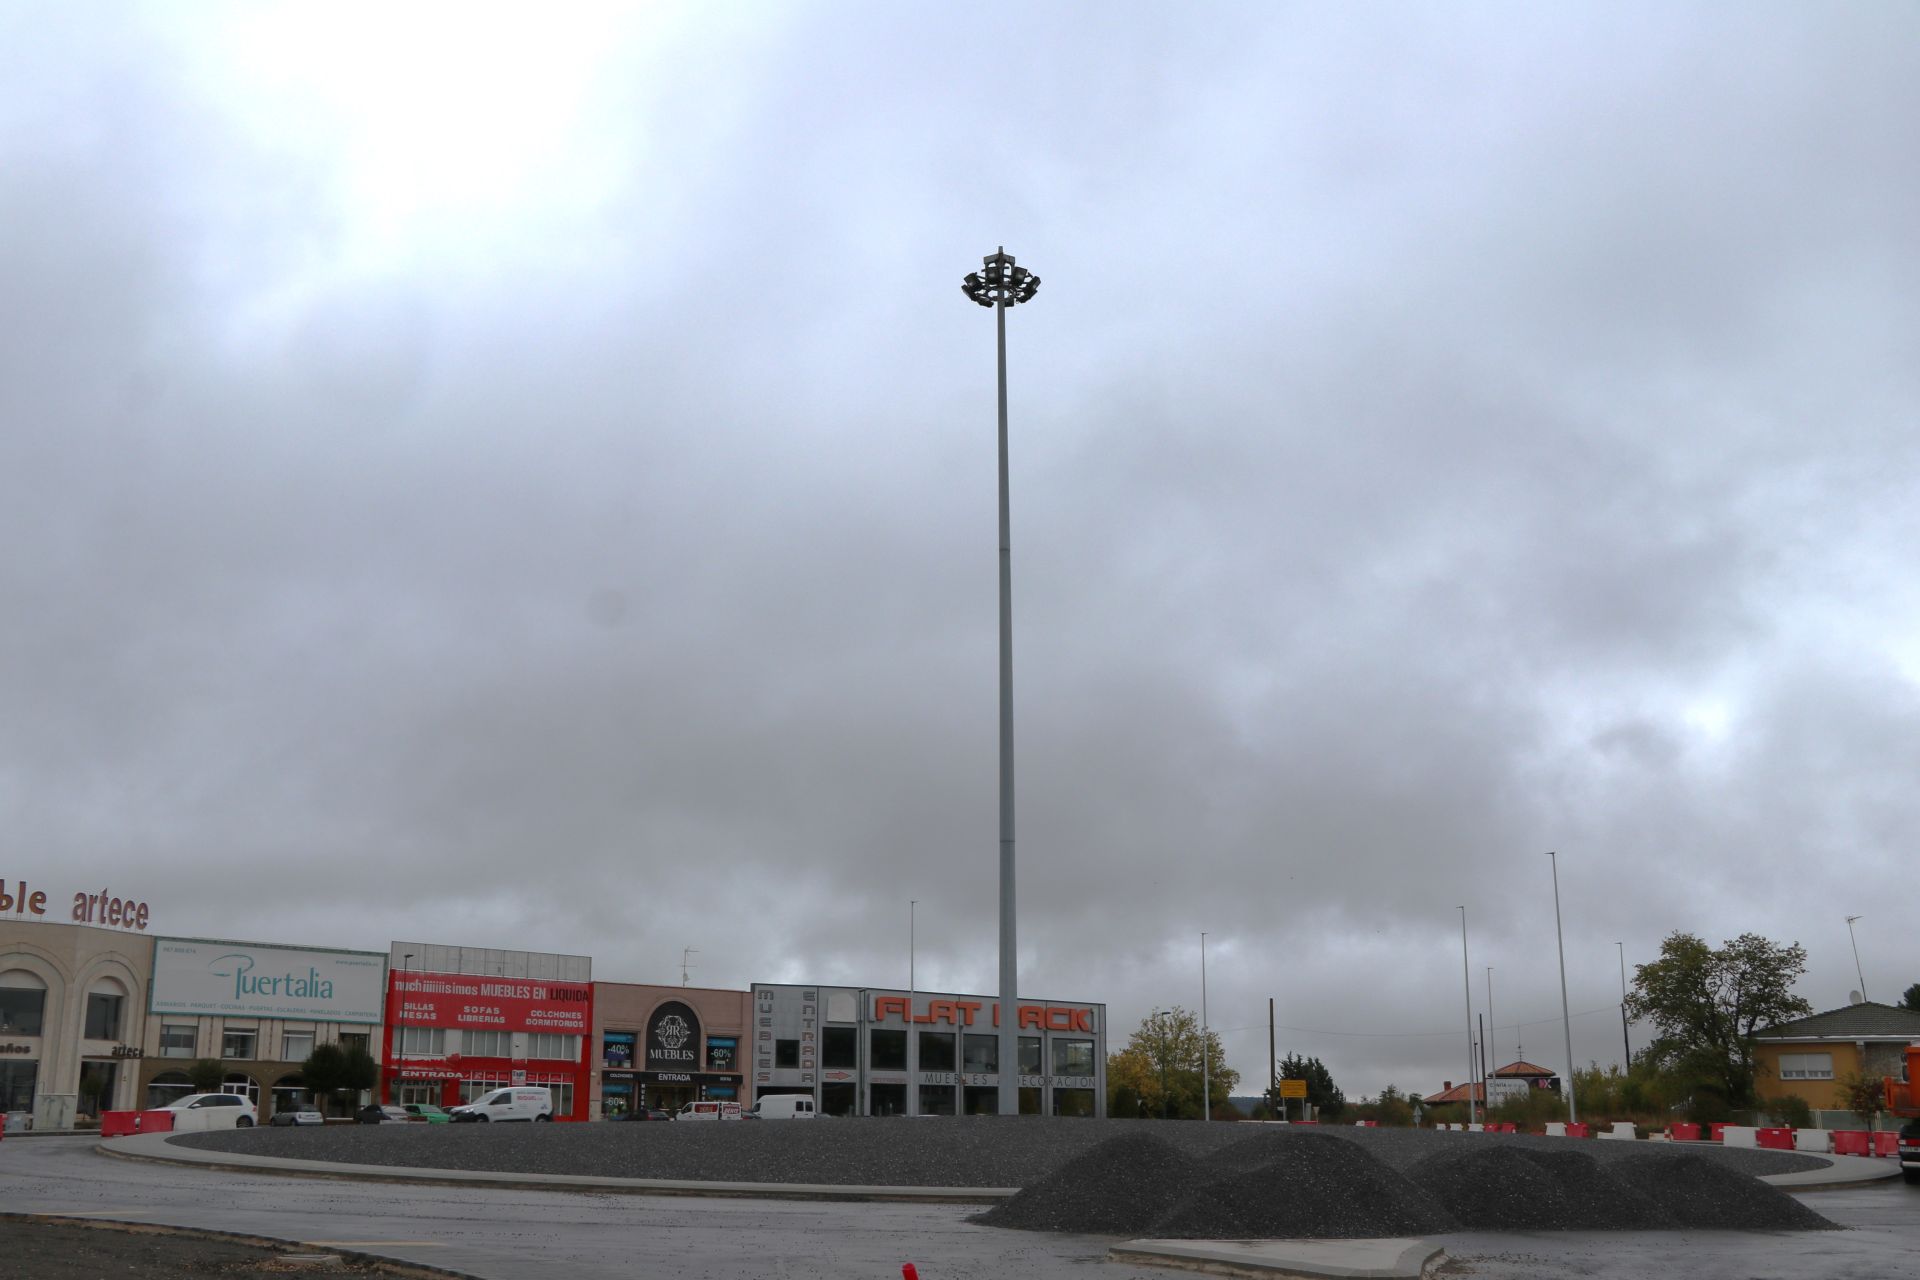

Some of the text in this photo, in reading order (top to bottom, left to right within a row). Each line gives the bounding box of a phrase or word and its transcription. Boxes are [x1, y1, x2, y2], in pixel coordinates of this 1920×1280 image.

[72, 888, 149, 930] artece
[208, 954, 333, 1001] Puertalia
[480, 983, 530, 999] MUEBLES
[533, 986, 547, 1000] EN
[403, 1002, 435, 1011] SILLAS
[463, 1005, 500, 1015] SOFAS
[399, 1011, 437, 1021] MESAS
[457, 1014, 506, 1024] LIBRERIAS
[530, 1010, 582, 1019] COLCHONES
[525, 1018, 584, 1028] DORMITORIOS
[757, 989, 774, 1082] MUEBLES
[801, 991, 816, 1083] ENTRADA
[111, 1042, 145, 1058] artece
[649, 1049, 694, 1060] MUEBLES
[710, 1048, 732, 1058] -60%
[401, 1070, 464, 1079] ENTRADA
[658, 1073, 692, 1081] ENTRADA
